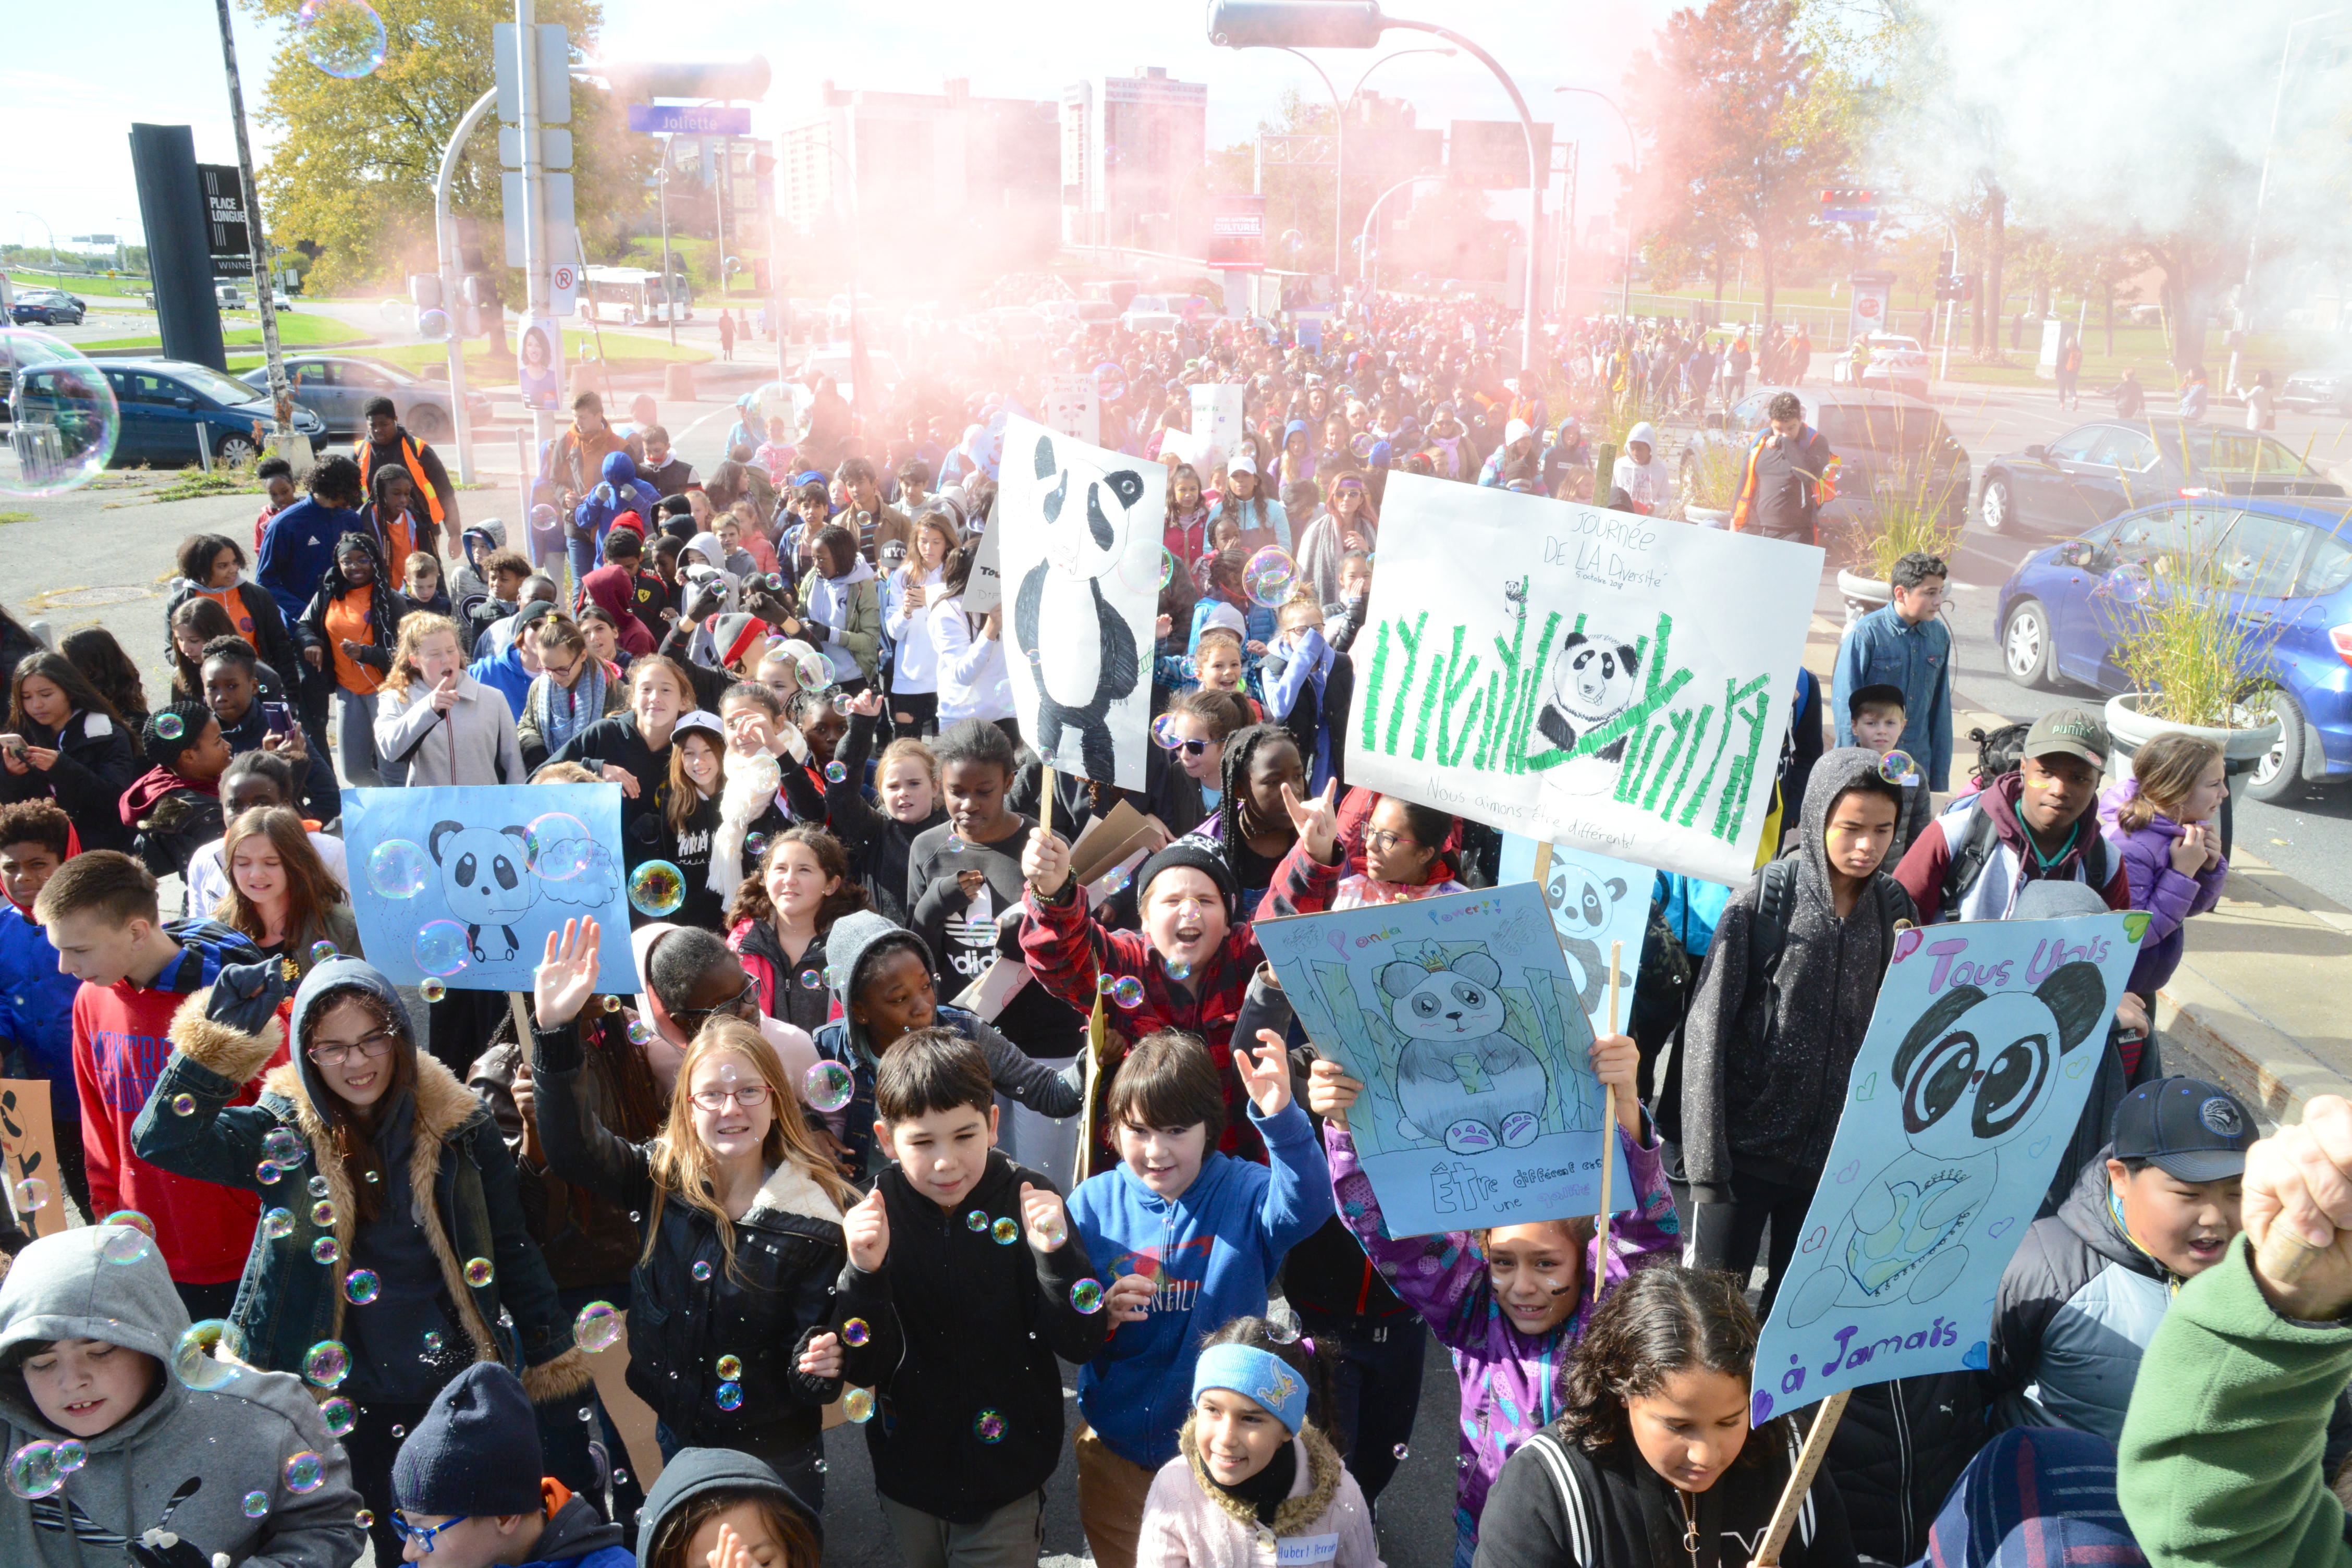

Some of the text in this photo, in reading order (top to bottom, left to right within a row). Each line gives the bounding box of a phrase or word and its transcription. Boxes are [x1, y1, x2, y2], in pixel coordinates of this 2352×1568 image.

[663, 116, 718, 130] Joliette
[210, 197, 236, 210] PLACE
[212, 210, 246, 222] LONGUE
[1213, 223, 1261, 231] CULTUREL
[218, 261, 251, 270] WINNE
[884, 547, 907, 558] NYC
[1544, 535, 1668, 588] DE LA Diversité
[1583, 573, 1607, 585] octobre
[1610, 579, 1623, 590] 2018
[1427, 776, 1636, 850] Nous aimons être différents!
[1327, 924, 1402, 961] Panda
[1926, 935, 2111, 995] Tous Unis
[1493, 1198, 1523, 1212] une
[1781, 1316, 1957, 1394] à Jamais
[1278, 1543, 1336, 1559] Hubert Perron
